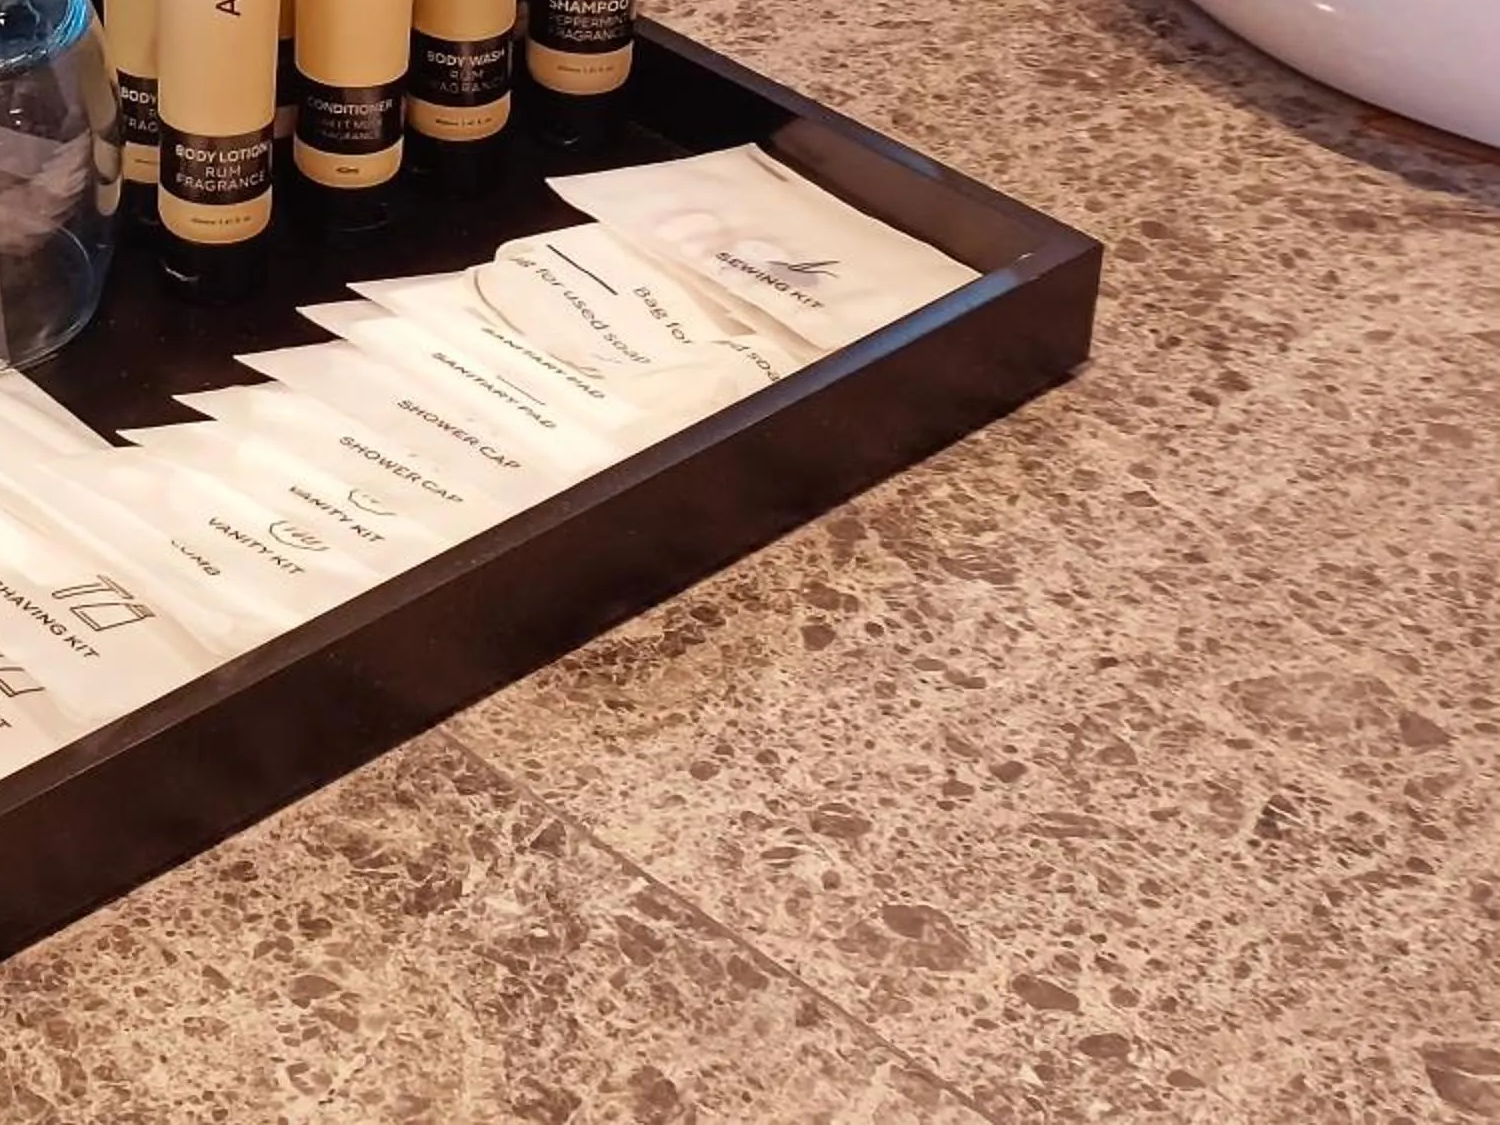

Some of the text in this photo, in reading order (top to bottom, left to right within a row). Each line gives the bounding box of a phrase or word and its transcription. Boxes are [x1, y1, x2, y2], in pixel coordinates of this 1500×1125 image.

[427, 50, 464, 67] BODY
[120, 86, 157, 105] BODY
[175, 142, 268, 163] BODY LOTION
[205, 165, 241, 178] RUM
[715, 252, 825, 308] SEWING KIT
[634, 286, 669, 319] Bag
[563, 290, 610, 330] used
[604, 333, 651, 364] soap
[746, 352, 781, 382] soa
[397, 399, 521, 469] SHOWER CAP
[339, 436, 464, 504] SHOWER CAP
[288, 485, 386, 543] VANITY KIT
[208, 516, 306, 575] VANITY KIT
[62, 634, 101, 660] KIT
